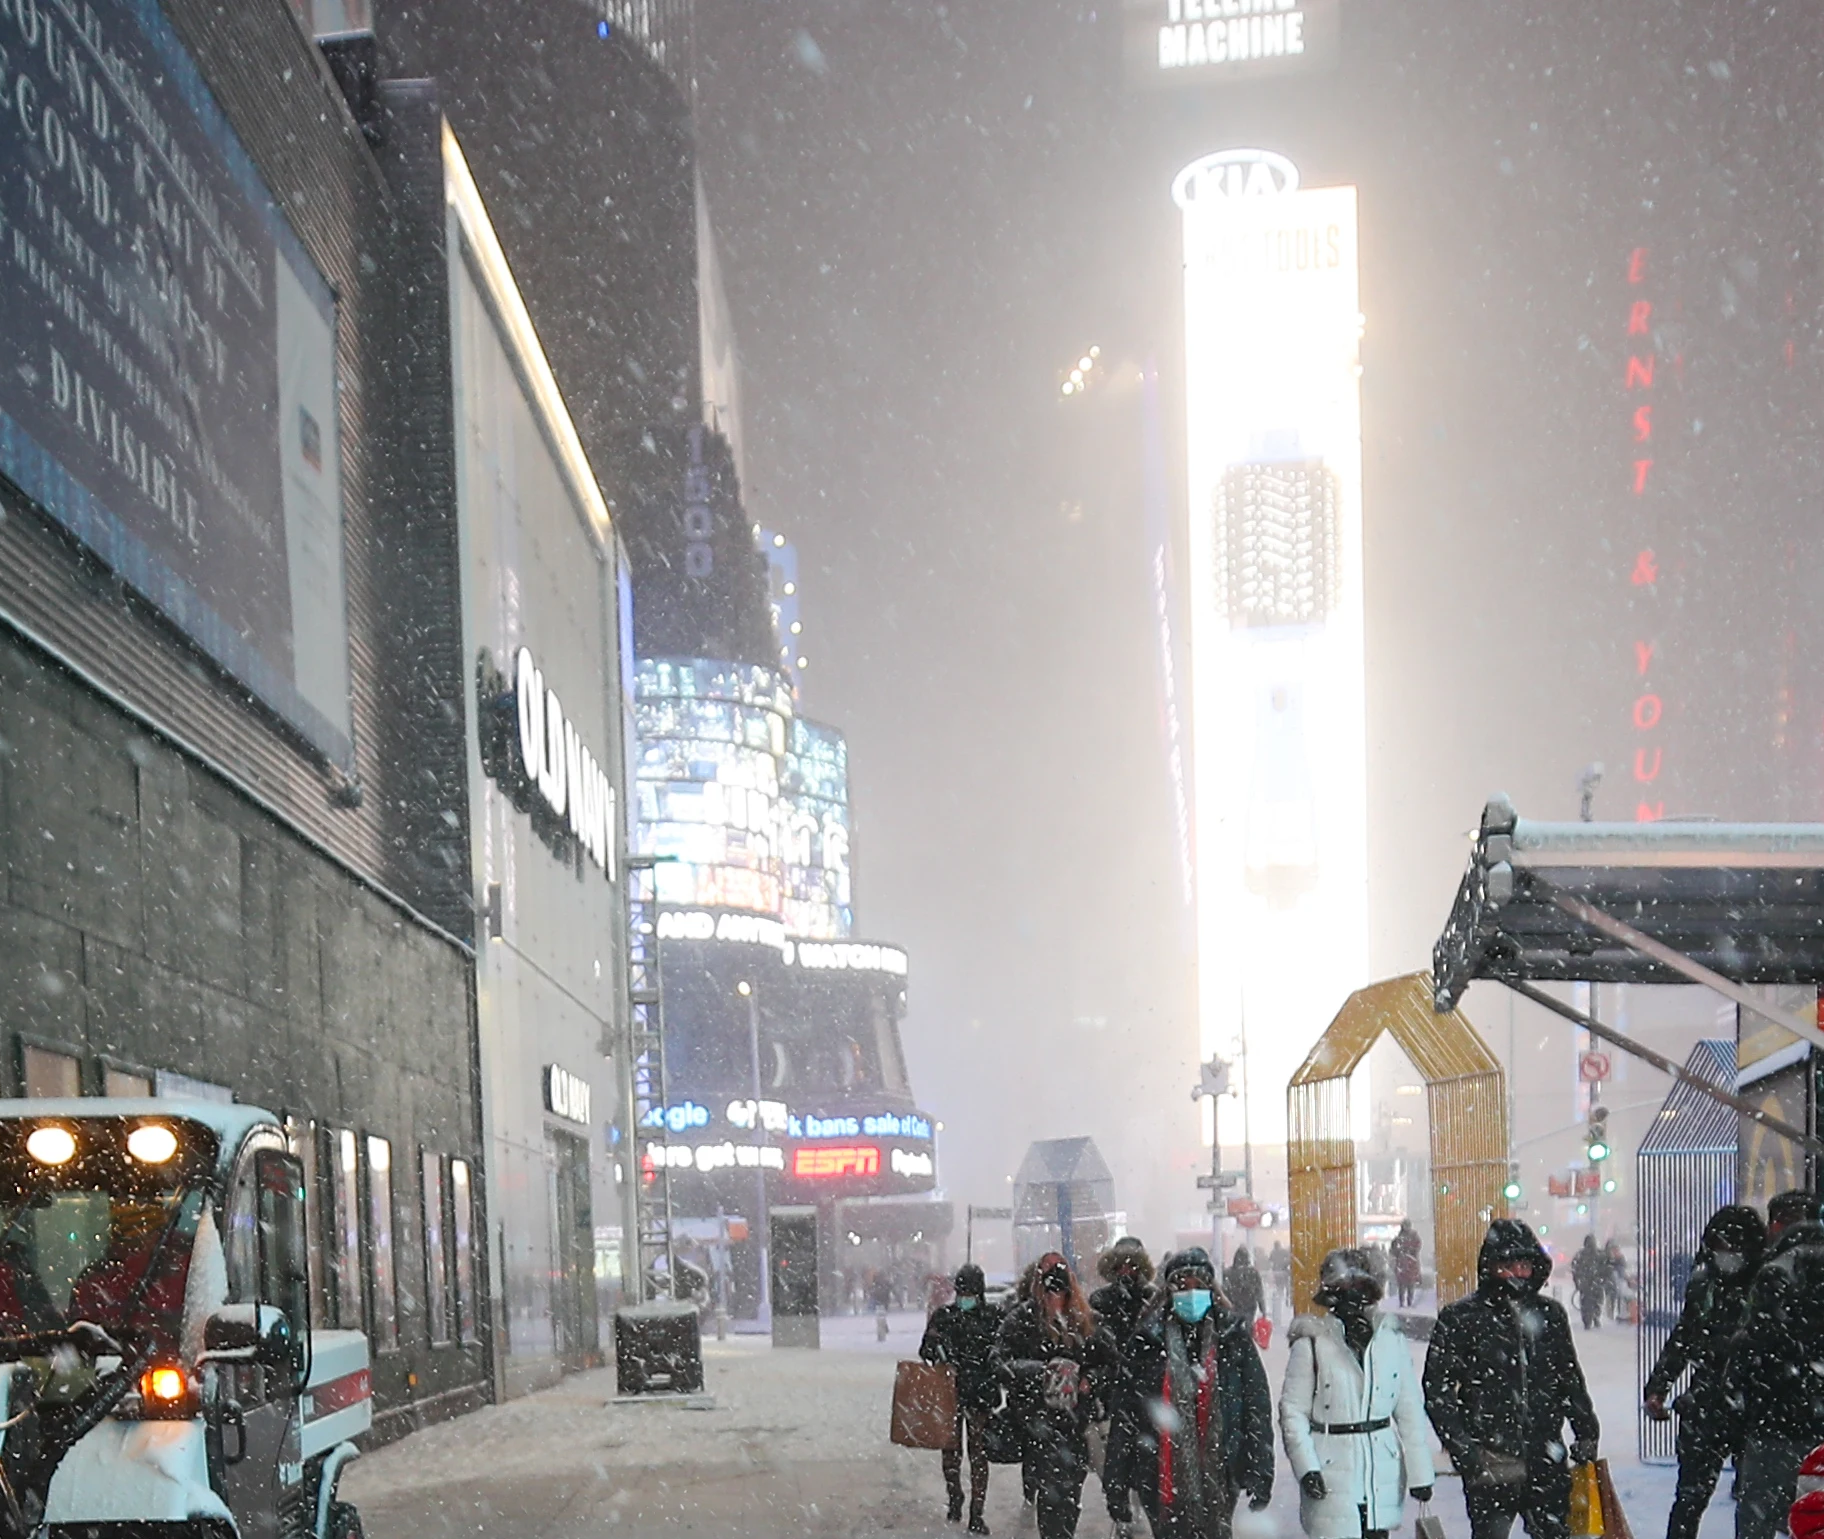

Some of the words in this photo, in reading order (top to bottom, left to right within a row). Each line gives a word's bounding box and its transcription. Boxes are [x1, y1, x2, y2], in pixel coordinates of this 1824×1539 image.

[1159, 12, 1304, 68] MACHINE
[1626, 246, 1654, 495] ERNST
[50, 342, 199, 547] DIVISIBLE
[1630, 551, 1658, 588] &
[517, 645, 567, 817] OLD
[565, 717, 616, 883] NAVY
[1632, 640, 1664, 824] YOUN
[793, 1147, 880, 1177] ESPN
[805, 1115, 860, 1138] bans
[862, 1112, 901, 1136] sale
